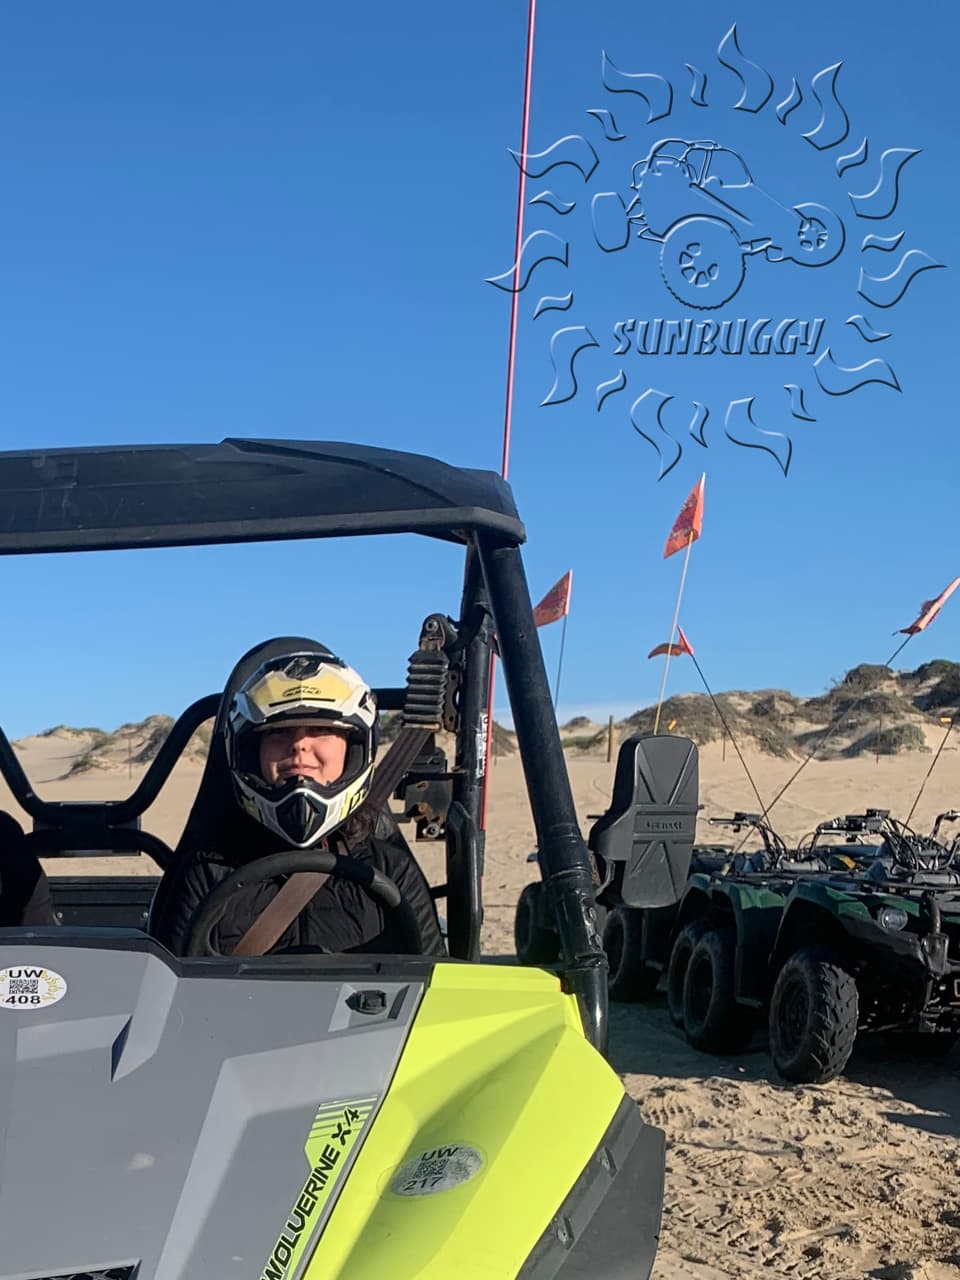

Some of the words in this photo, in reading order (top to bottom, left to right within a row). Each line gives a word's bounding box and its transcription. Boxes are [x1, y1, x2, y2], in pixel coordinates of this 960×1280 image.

[9, 969, 44, 978] UW
[5, 995, 41, 1004] 408
[421, 1147, 459, 1161] UW
[402, 1176, 443, 1192] 217
